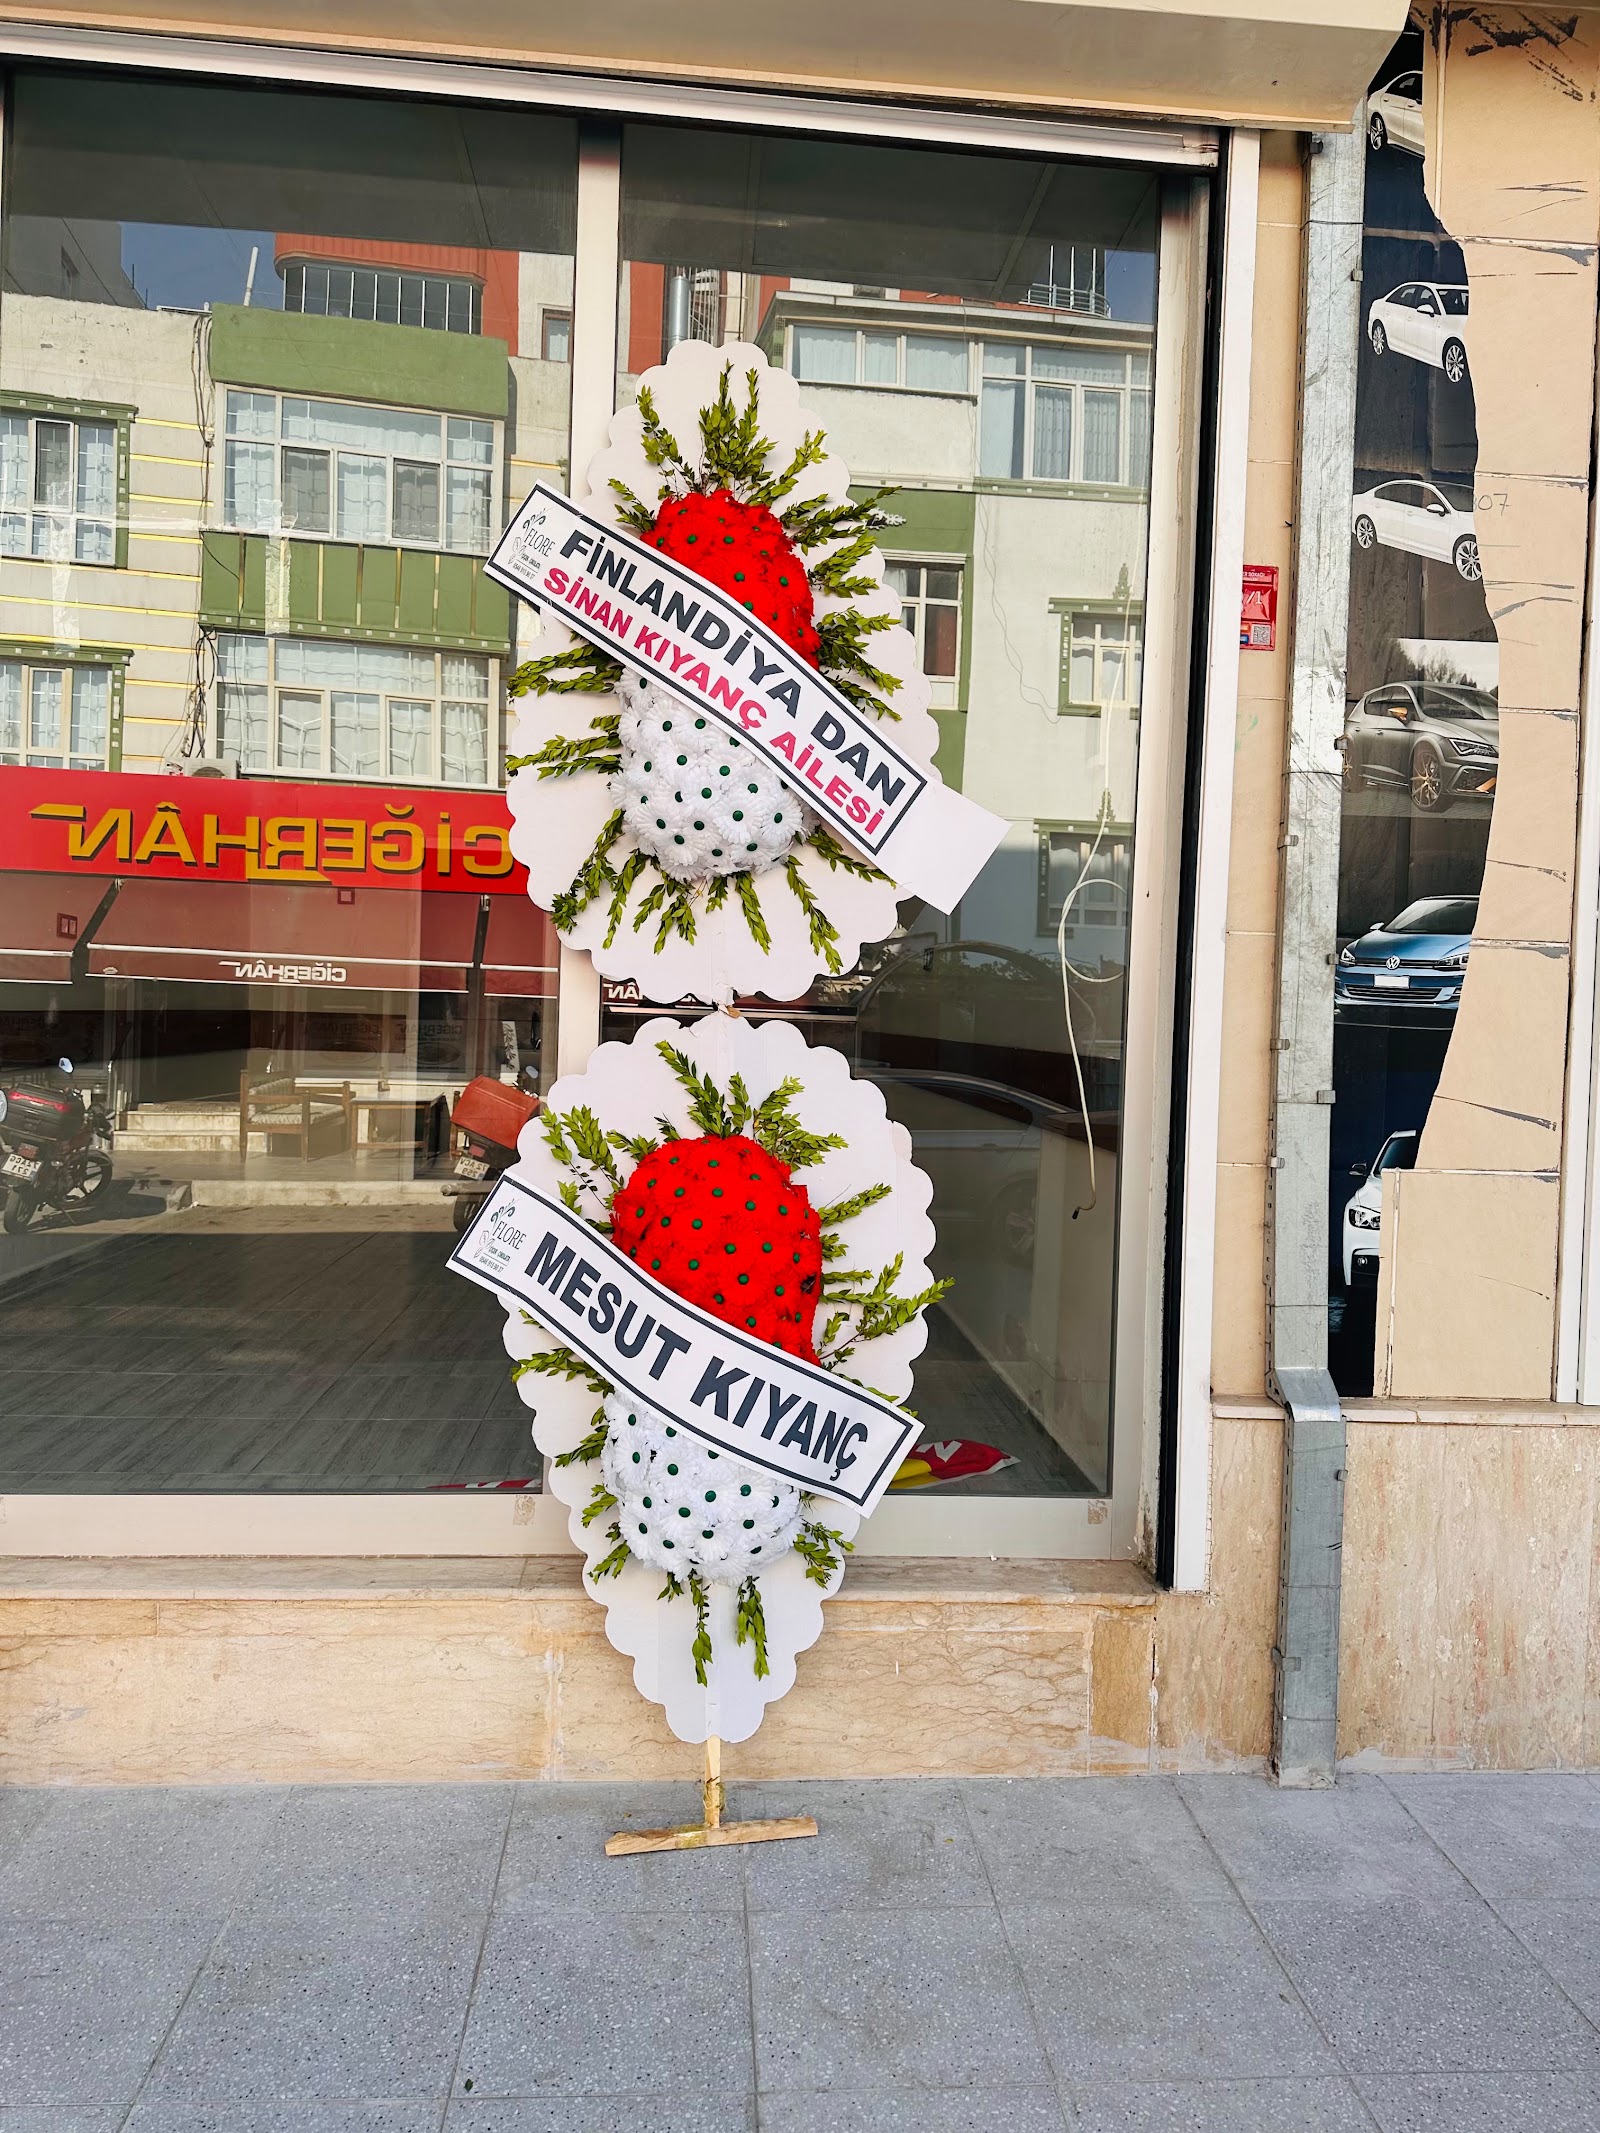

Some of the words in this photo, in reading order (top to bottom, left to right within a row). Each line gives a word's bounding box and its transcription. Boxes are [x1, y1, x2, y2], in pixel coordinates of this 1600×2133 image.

[524, 528, 555, 557] FLORE
[544, 567, 633, 638] SİNAN
[634, 625, 768, 730] KIYANÇ
[770, 731, 888, 836] AİLESİ
[559, 529, 801, 719] FİNLANDİYA
[810, 711, 906, 807] DAN
[492, 1220, 527, 1250] FLORE
[524, 1231, 692, 1381] MESUT
[690, 1356, 869, 1480] KIYANÇ
